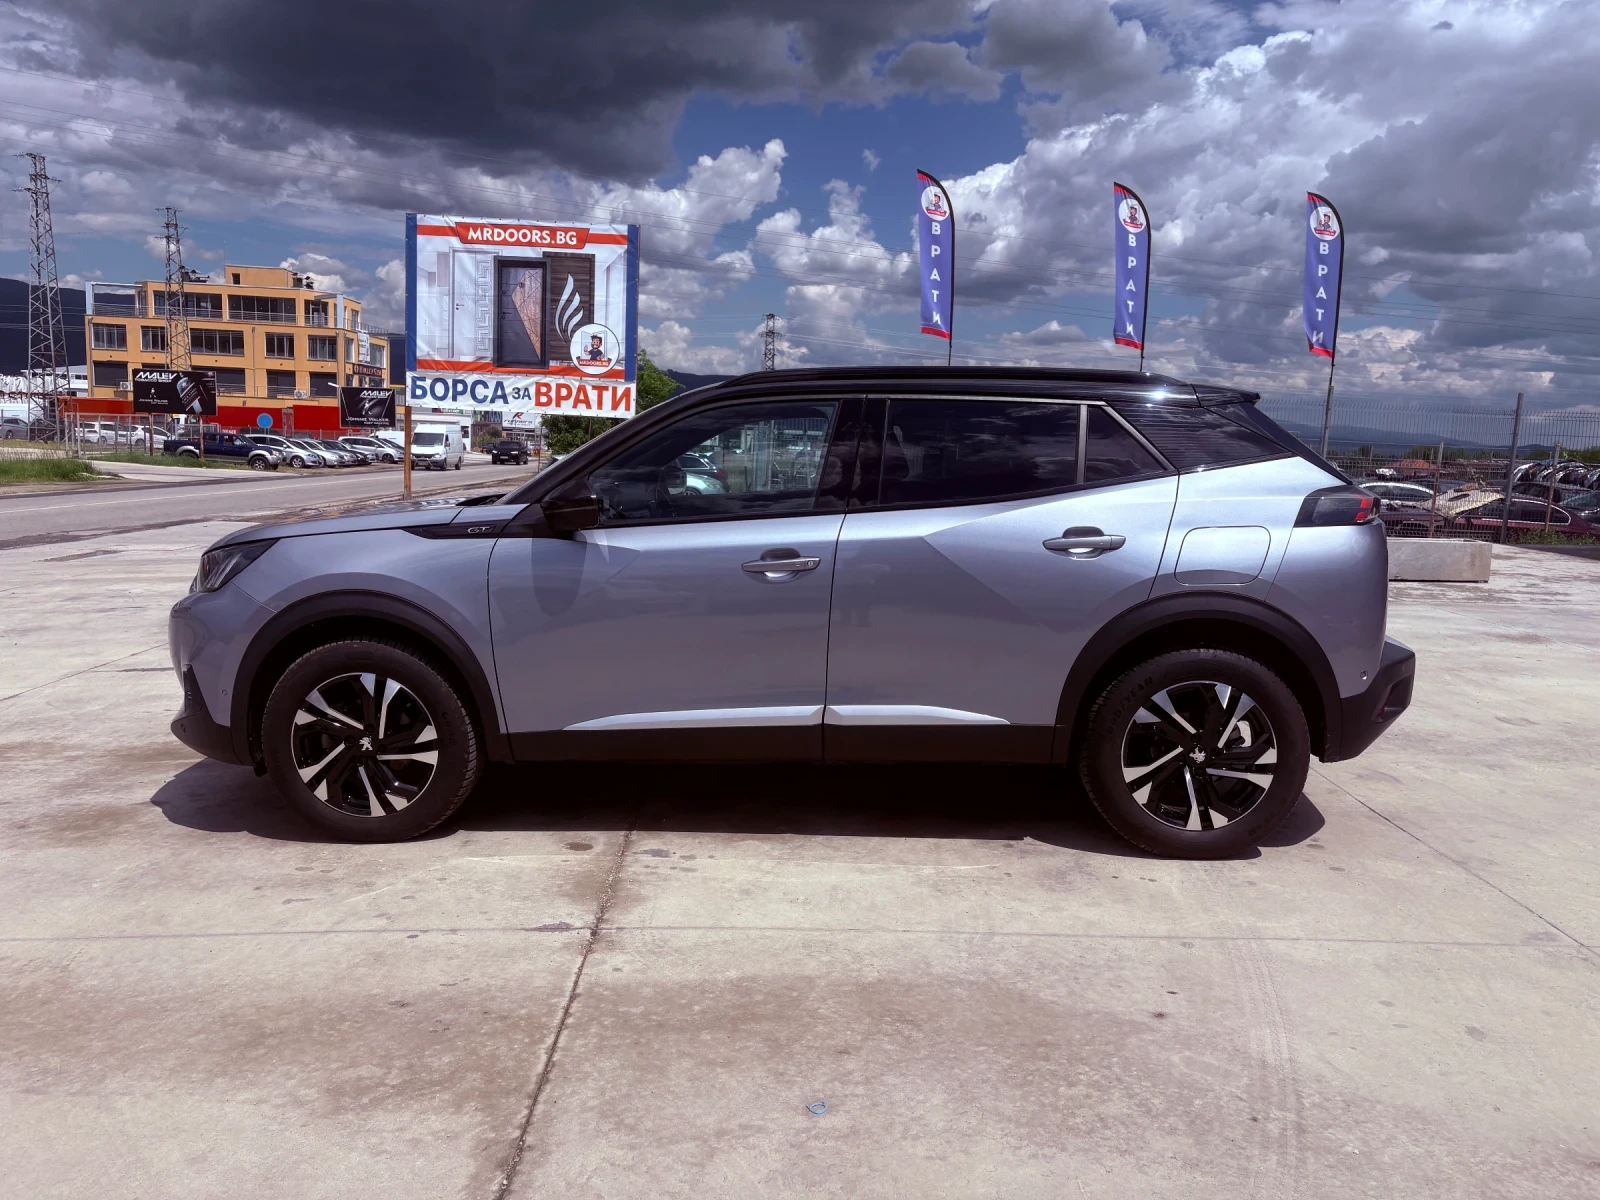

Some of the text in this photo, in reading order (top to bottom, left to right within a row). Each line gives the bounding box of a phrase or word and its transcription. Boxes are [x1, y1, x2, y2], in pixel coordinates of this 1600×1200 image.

[467, 227, 577, 245] MRDOORS.BG
[930, 222, 941, 325] ВРАТИ
[1125, 233, 1137, 336] ВРАТИ
[1312, 242, 1330, 344] ВРАТИ
[135, 371, 177, 380] MALEV
[410, 376, 631, 412] БОРСА ЗА ВРАТИ
[467, 526, 490, 534] GT
